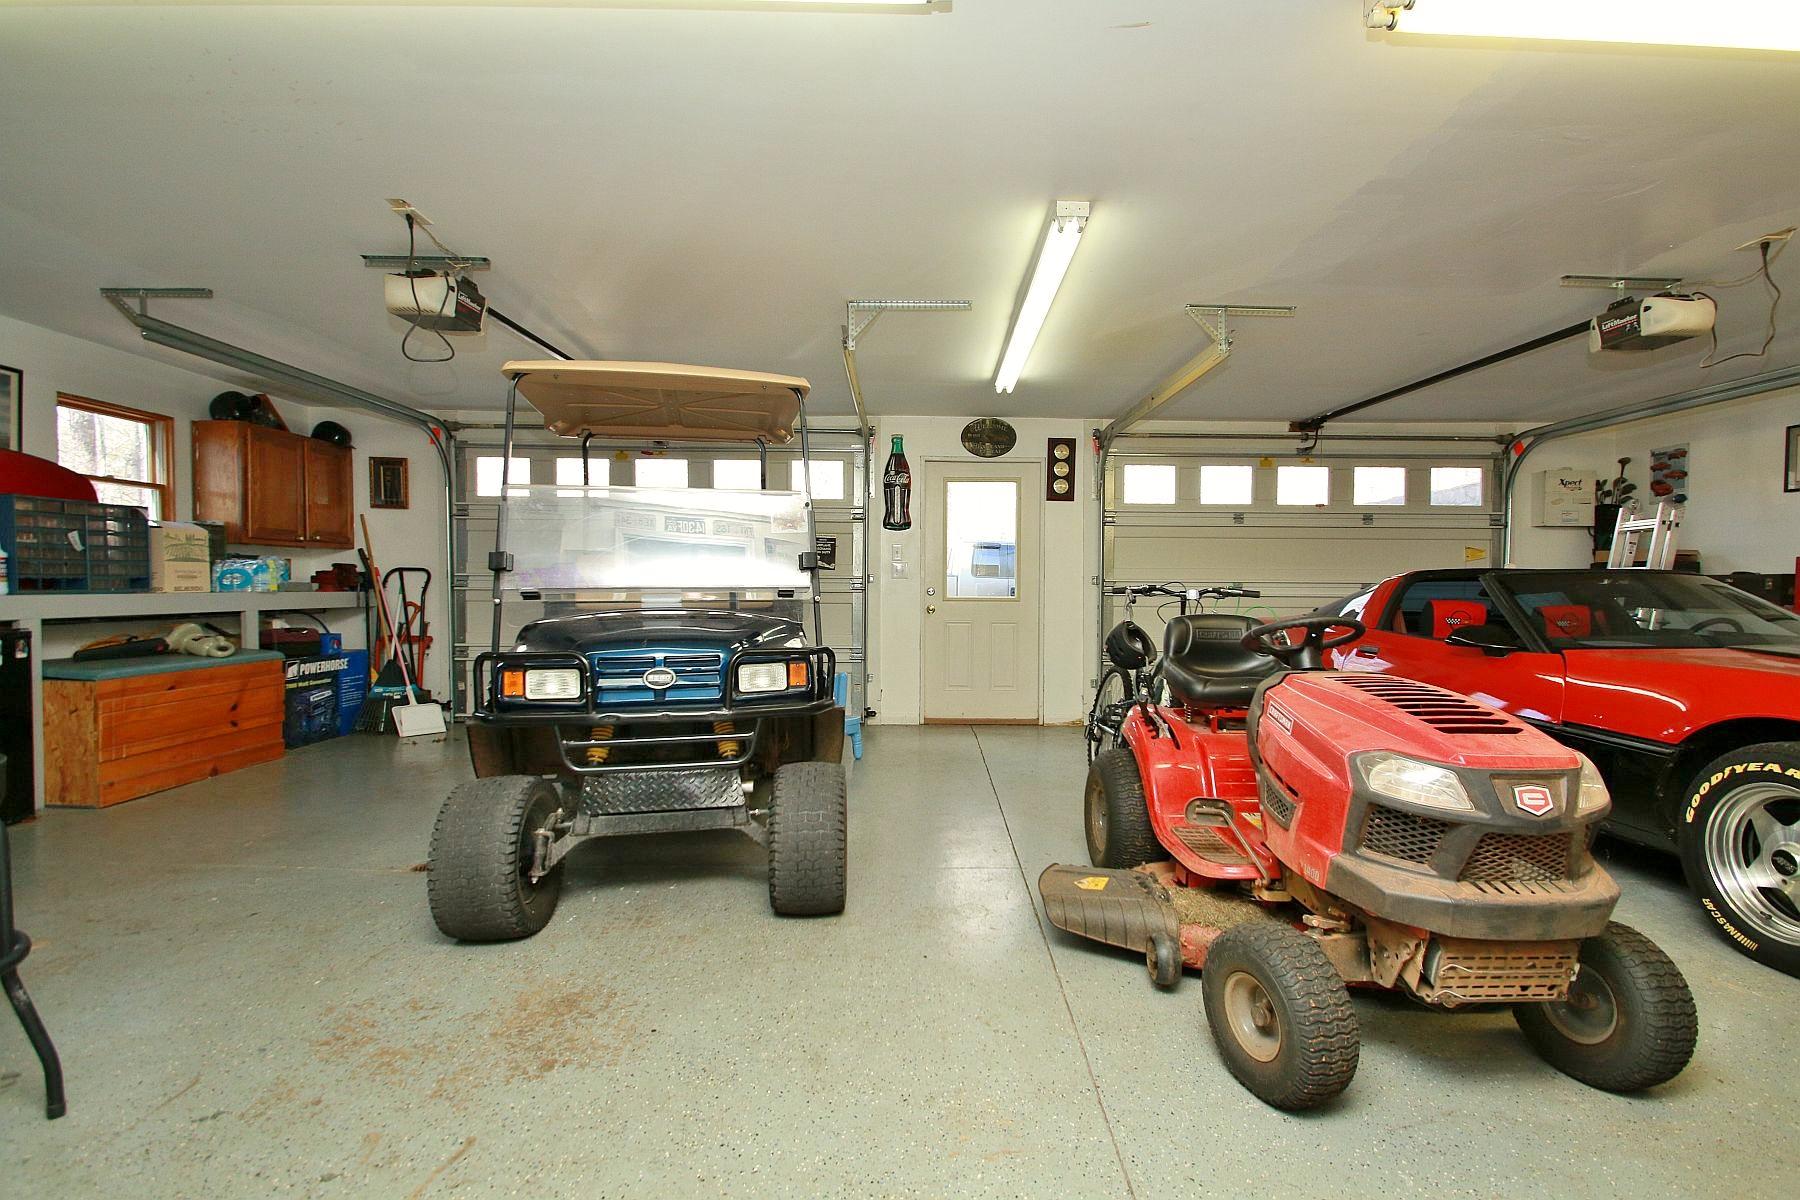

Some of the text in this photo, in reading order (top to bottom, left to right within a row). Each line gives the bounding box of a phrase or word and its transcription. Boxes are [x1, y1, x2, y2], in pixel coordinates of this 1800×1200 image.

[1558, 478, 1582, 489] Xpert
[300, 657, 349, 676] POWERHORSE
[1685, 762, 1800, 823] GOODYEAR
[1702, 898, 1738, 939] NASCAR
